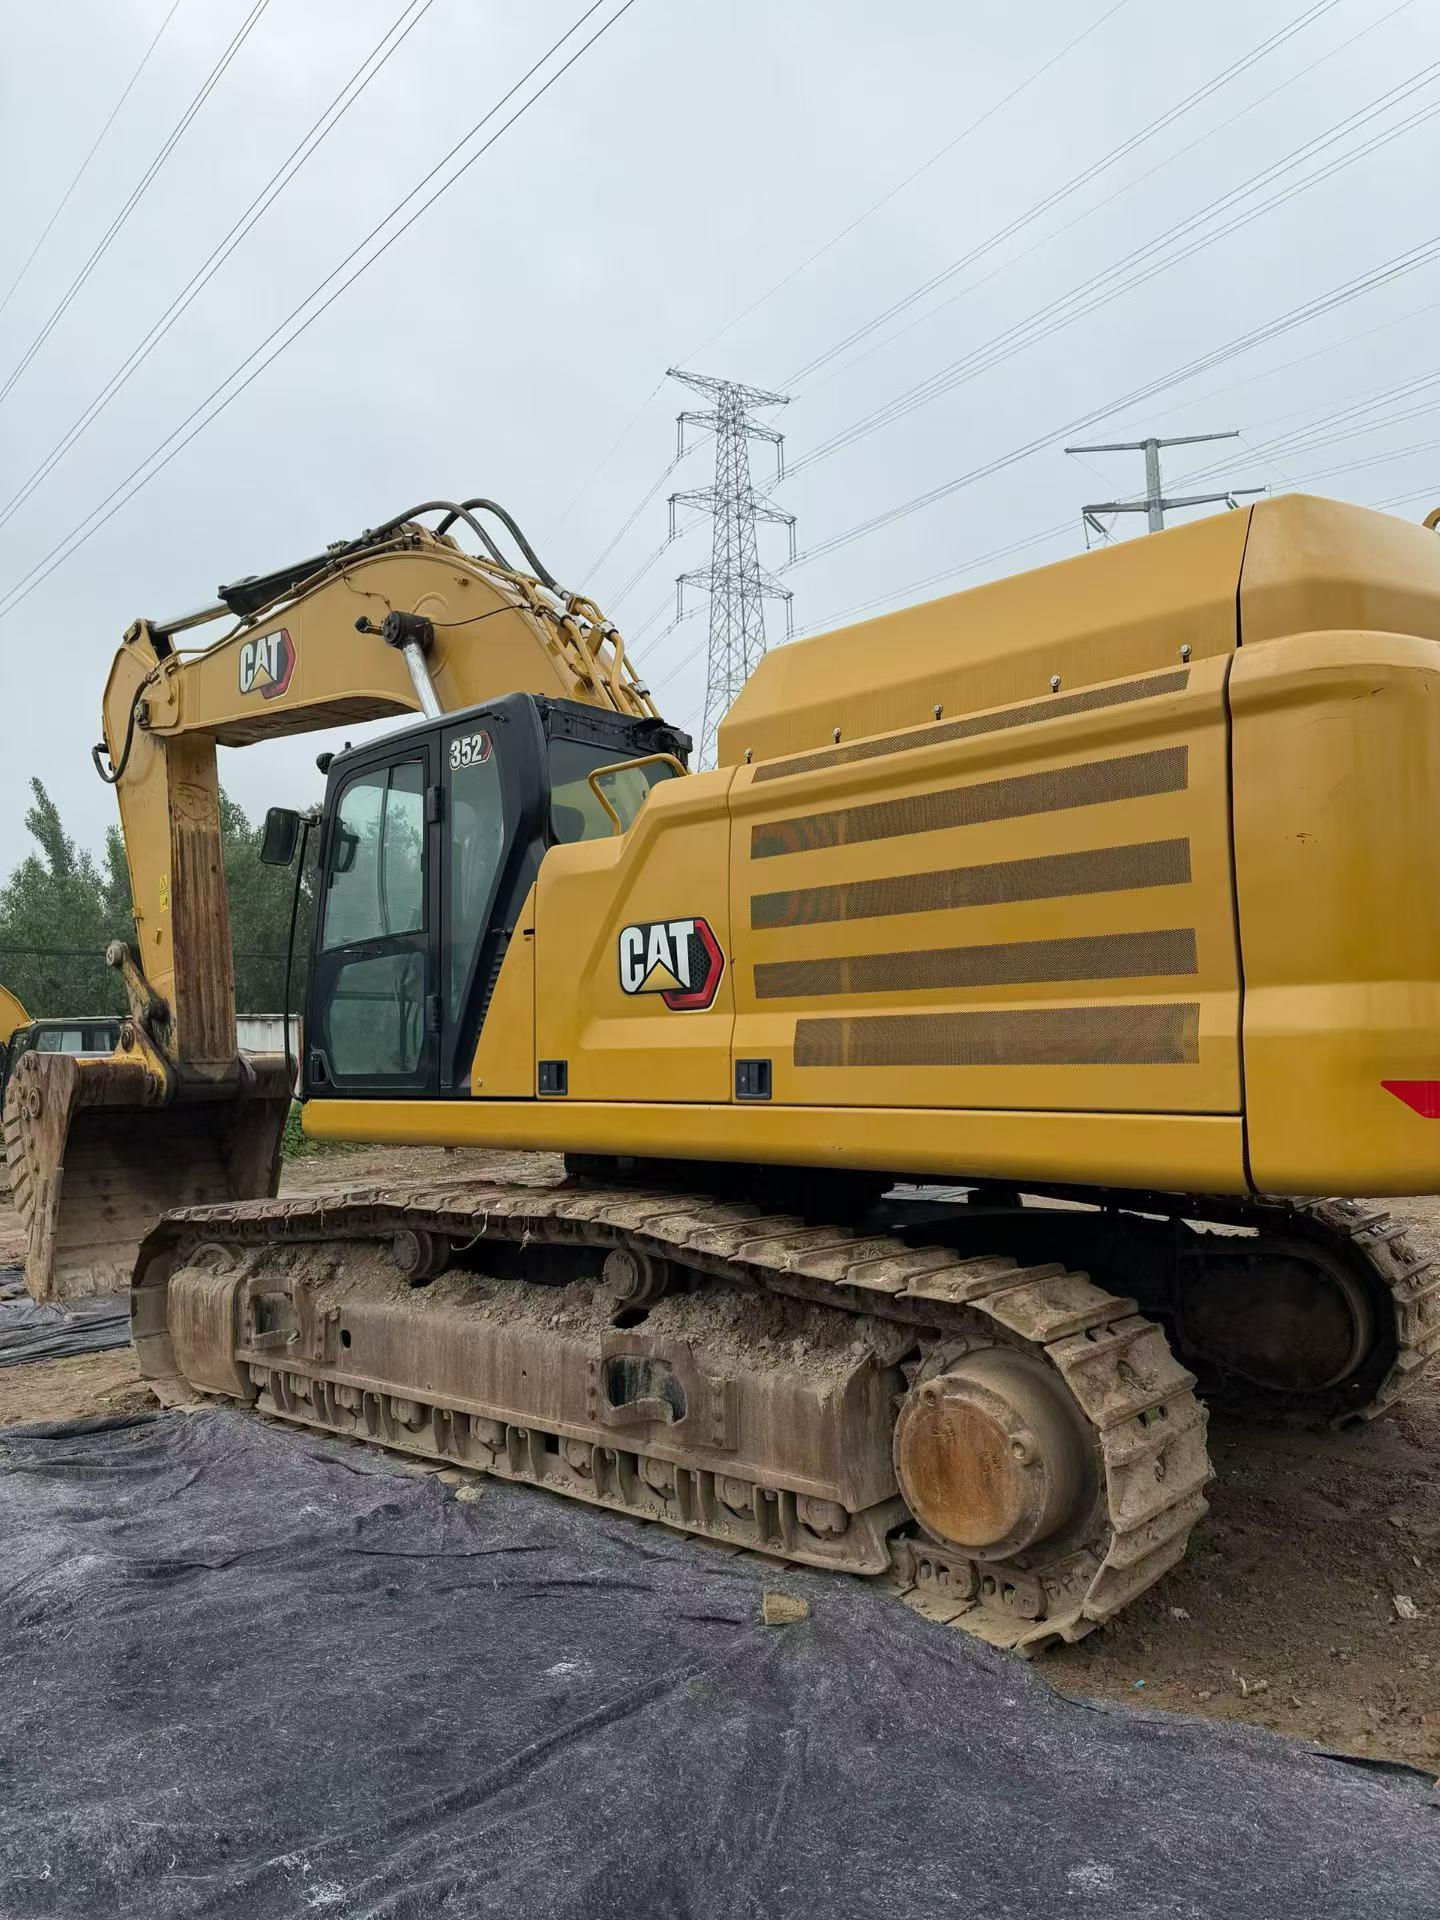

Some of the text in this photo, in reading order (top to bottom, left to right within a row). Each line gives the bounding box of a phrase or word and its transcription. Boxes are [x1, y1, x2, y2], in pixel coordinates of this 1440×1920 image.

[241, 631, 282, 693] CAT
[450, 734, 482, 767] 352
[620, 920, 694, 993] CAT
